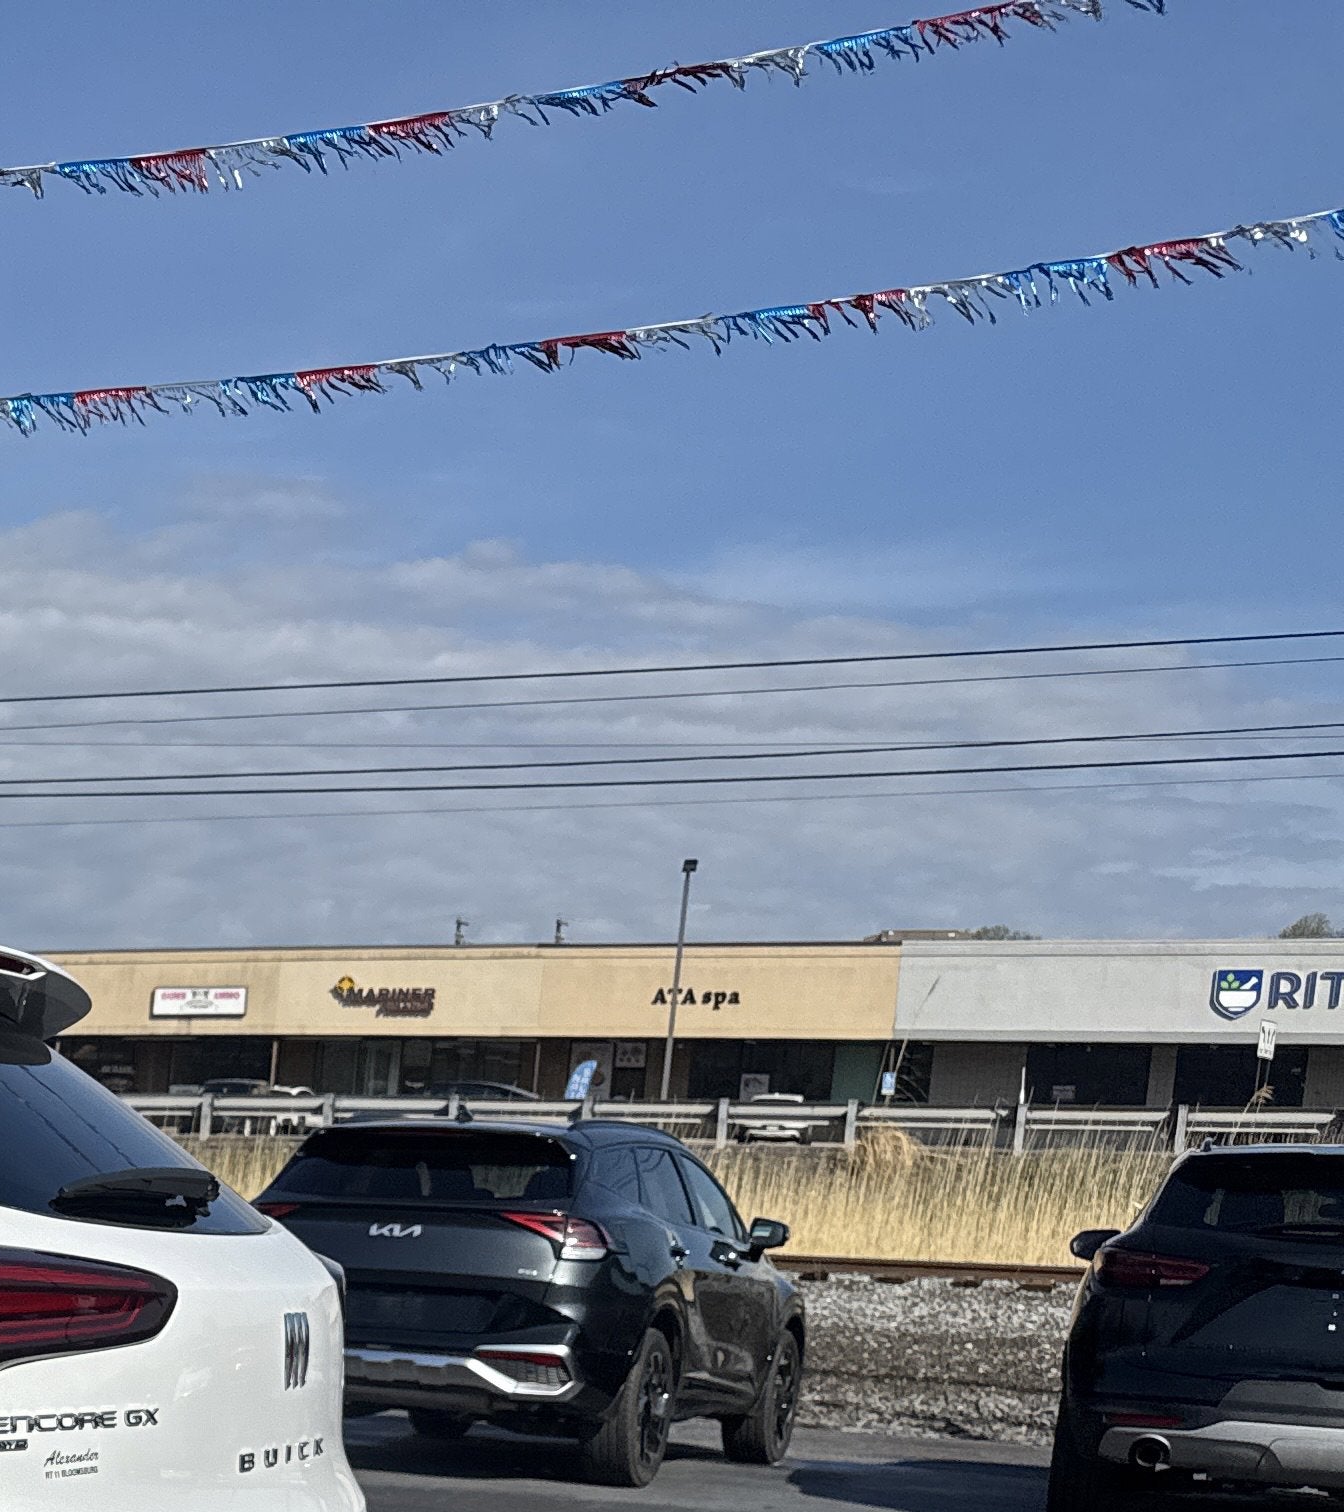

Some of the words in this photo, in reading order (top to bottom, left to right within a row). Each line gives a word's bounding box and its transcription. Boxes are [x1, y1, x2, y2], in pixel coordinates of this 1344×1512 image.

[346, 987, 435, 1002] MARINER
[702, 991, 741, 1011] spa
[368, 1223, 423, 1237] KIA
[124, 1408, 159, 1427] GX
[44, 1448, 99, 1467] Alexander
[239, 1438, 323, 1473] BUICK
